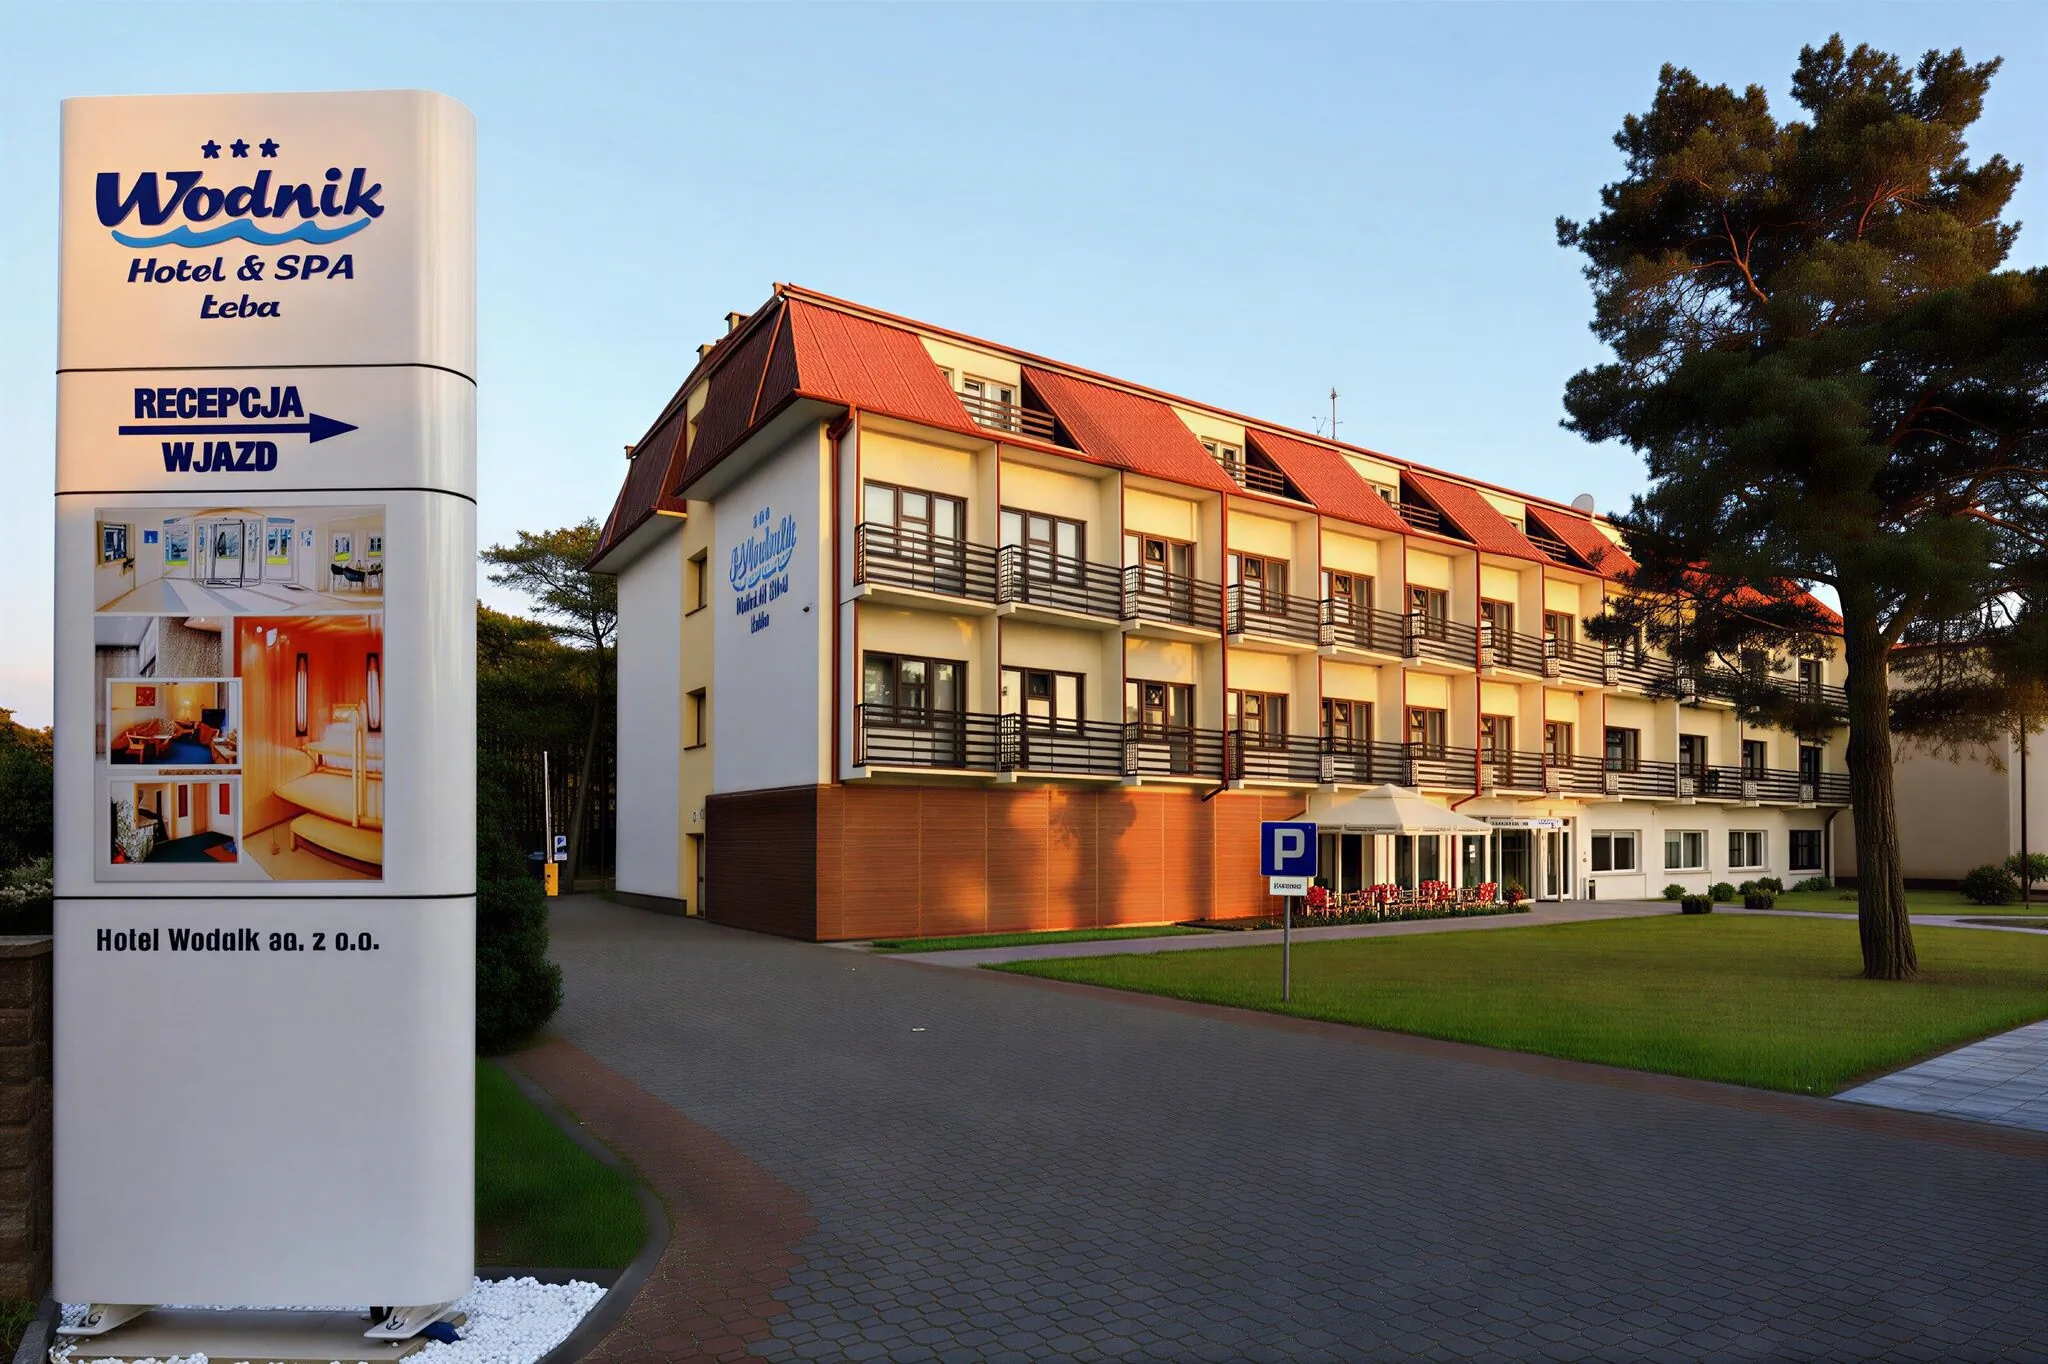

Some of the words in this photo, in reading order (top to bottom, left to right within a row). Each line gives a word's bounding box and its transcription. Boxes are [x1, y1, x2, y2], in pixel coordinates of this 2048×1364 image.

[95, 167, 385, 227] Wodnik
[127, 256, 226, 283] Hotel
[236, 254, 266, 282] &
[274, 254, 354, 280] SPA
[134, 386, 304, 419] RECEPCJA
[162, 441, 278, 472] WJAZD
[1274, 828, 1305, 871] P
[97, 928, 159, 951] Hotel
[335, 932, 380, 951] o.o.
